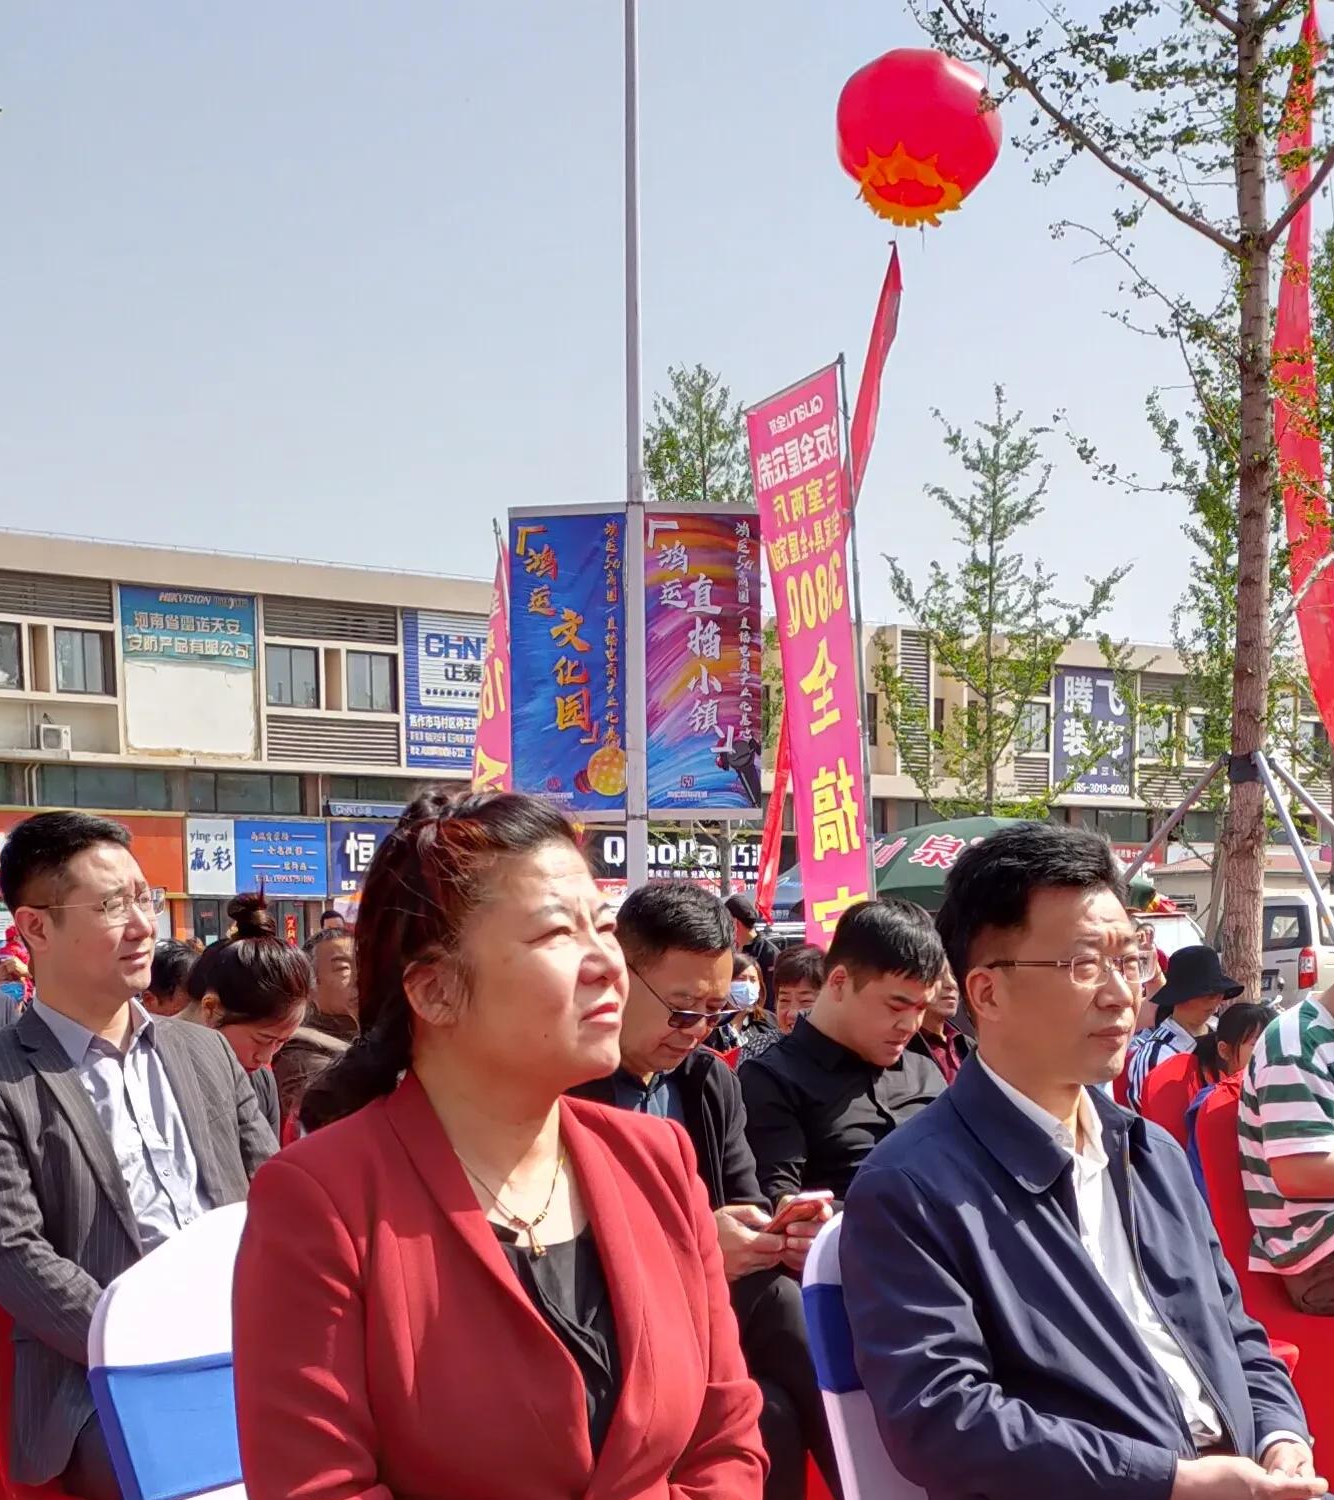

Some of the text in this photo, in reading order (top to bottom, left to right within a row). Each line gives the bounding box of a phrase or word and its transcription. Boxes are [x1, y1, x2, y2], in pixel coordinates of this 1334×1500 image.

[158, 591, 211, 606] HIKVISION
[126, 634, 251, 660] 安防产品有限公司
[444, 662, 482, 684] 正泰
[1063, 675, 1126, 716] 腾飞
